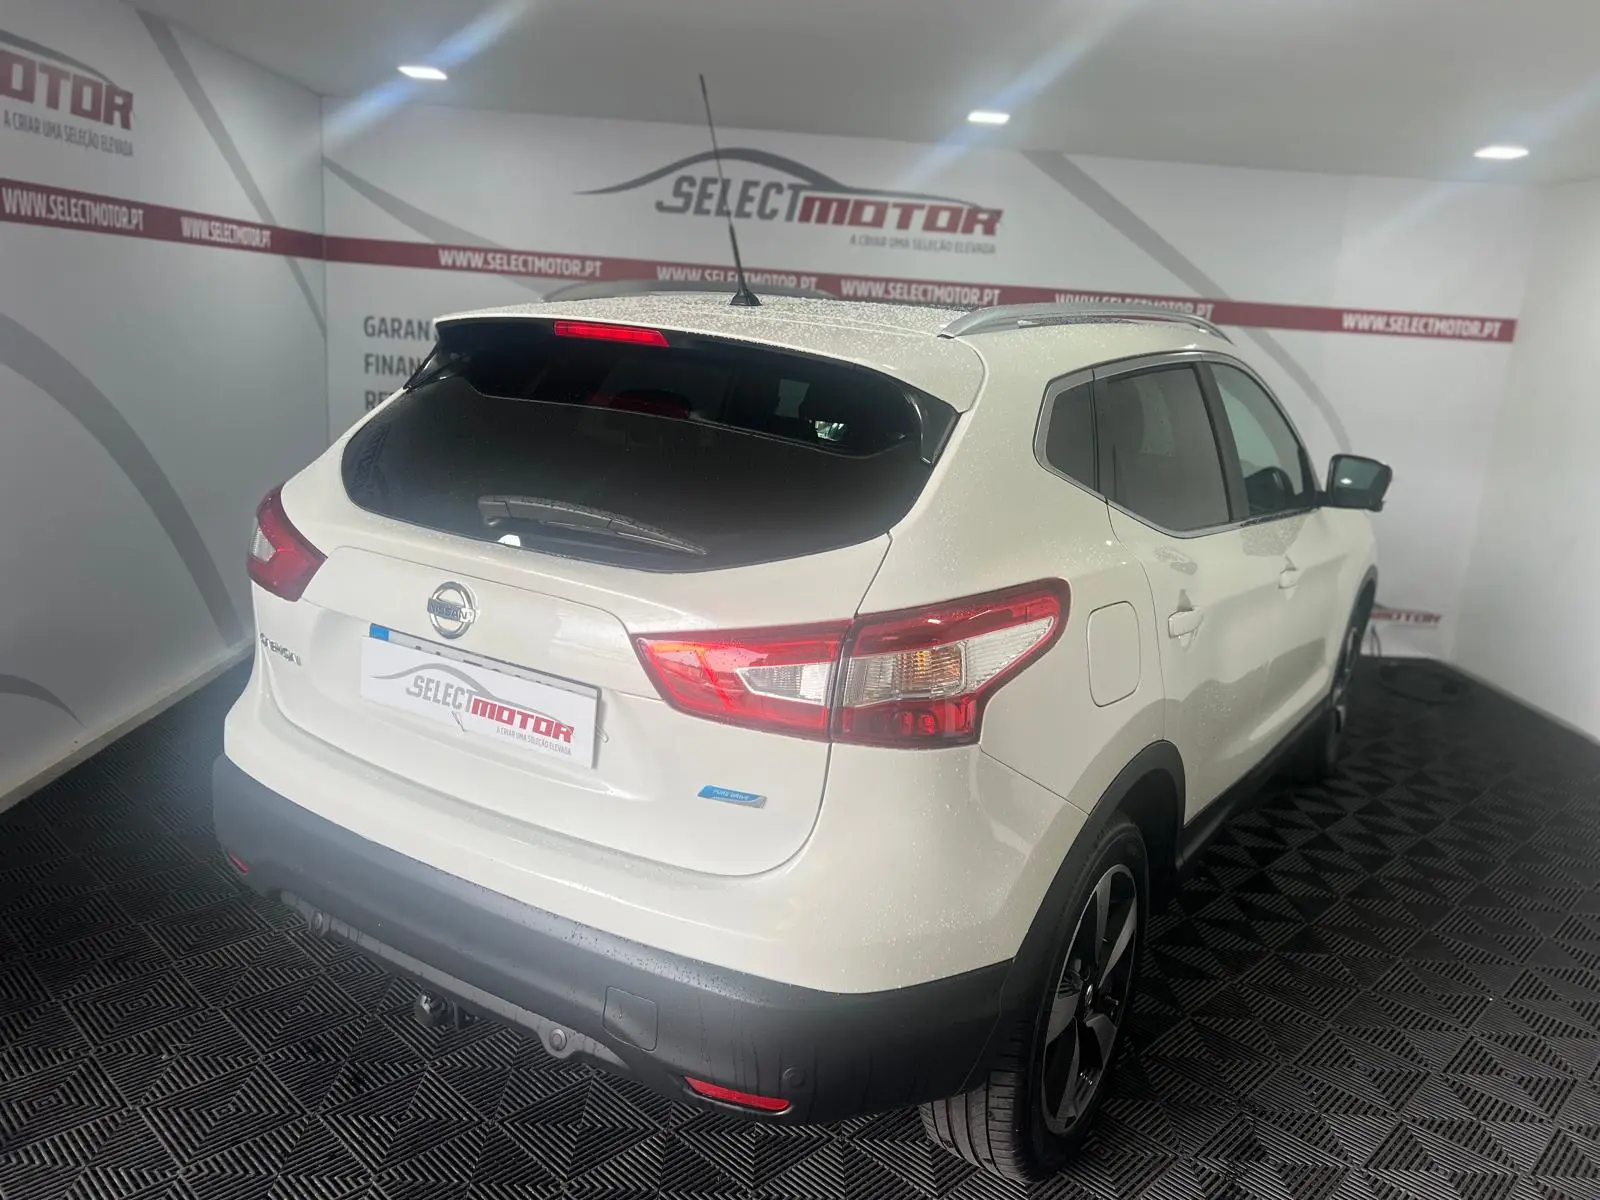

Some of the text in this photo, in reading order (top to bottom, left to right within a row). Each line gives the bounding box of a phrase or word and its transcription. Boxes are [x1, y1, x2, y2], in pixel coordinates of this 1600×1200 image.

[12, 111, 41, 135] CRIAR
[42, 120, 62, 140] UMA
[100, 133, 134, 157] ELEVADA
[2, 186, 144, 231] WWW.SELECTMOTOR.PT
[438, 248, 603, 277] WWW.SELECTMOTOR.PT
[840, 279, 1001, 306] WWW.SELECTMOTOR.PT
[1342, 312, 1502, 339] WWW.SELECTMOTOR.PT
